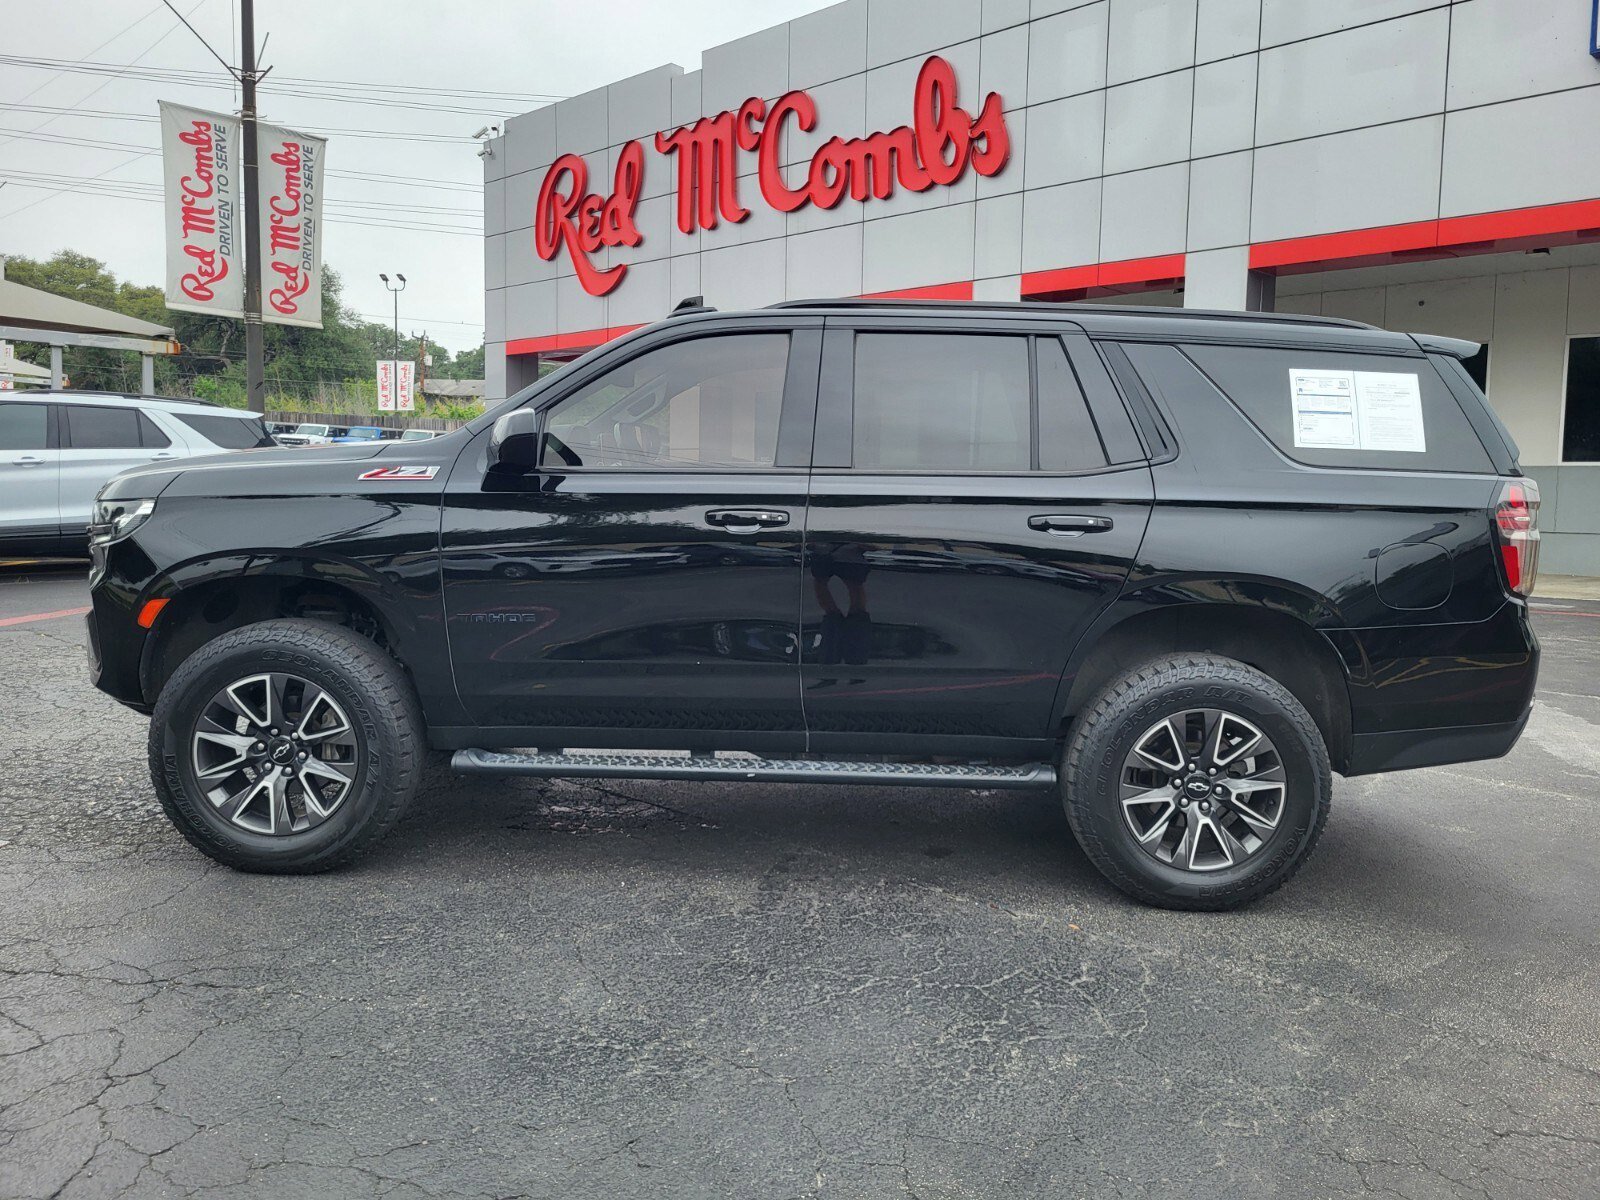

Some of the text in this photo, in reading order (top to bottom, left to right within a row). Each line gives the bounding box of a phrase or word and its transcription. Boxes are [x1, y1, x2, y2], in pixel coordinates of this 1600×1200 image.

[179, 120, 229, 302] Red McCombs
[214, 123, 230, 256] DRIVEN TO SERVE
[269, 141, 310, 315] Red McCombs
[302, 144, 314, 272] DRIVEN TO SERVE
[535, 55, 1011, 296] Red McCombs
